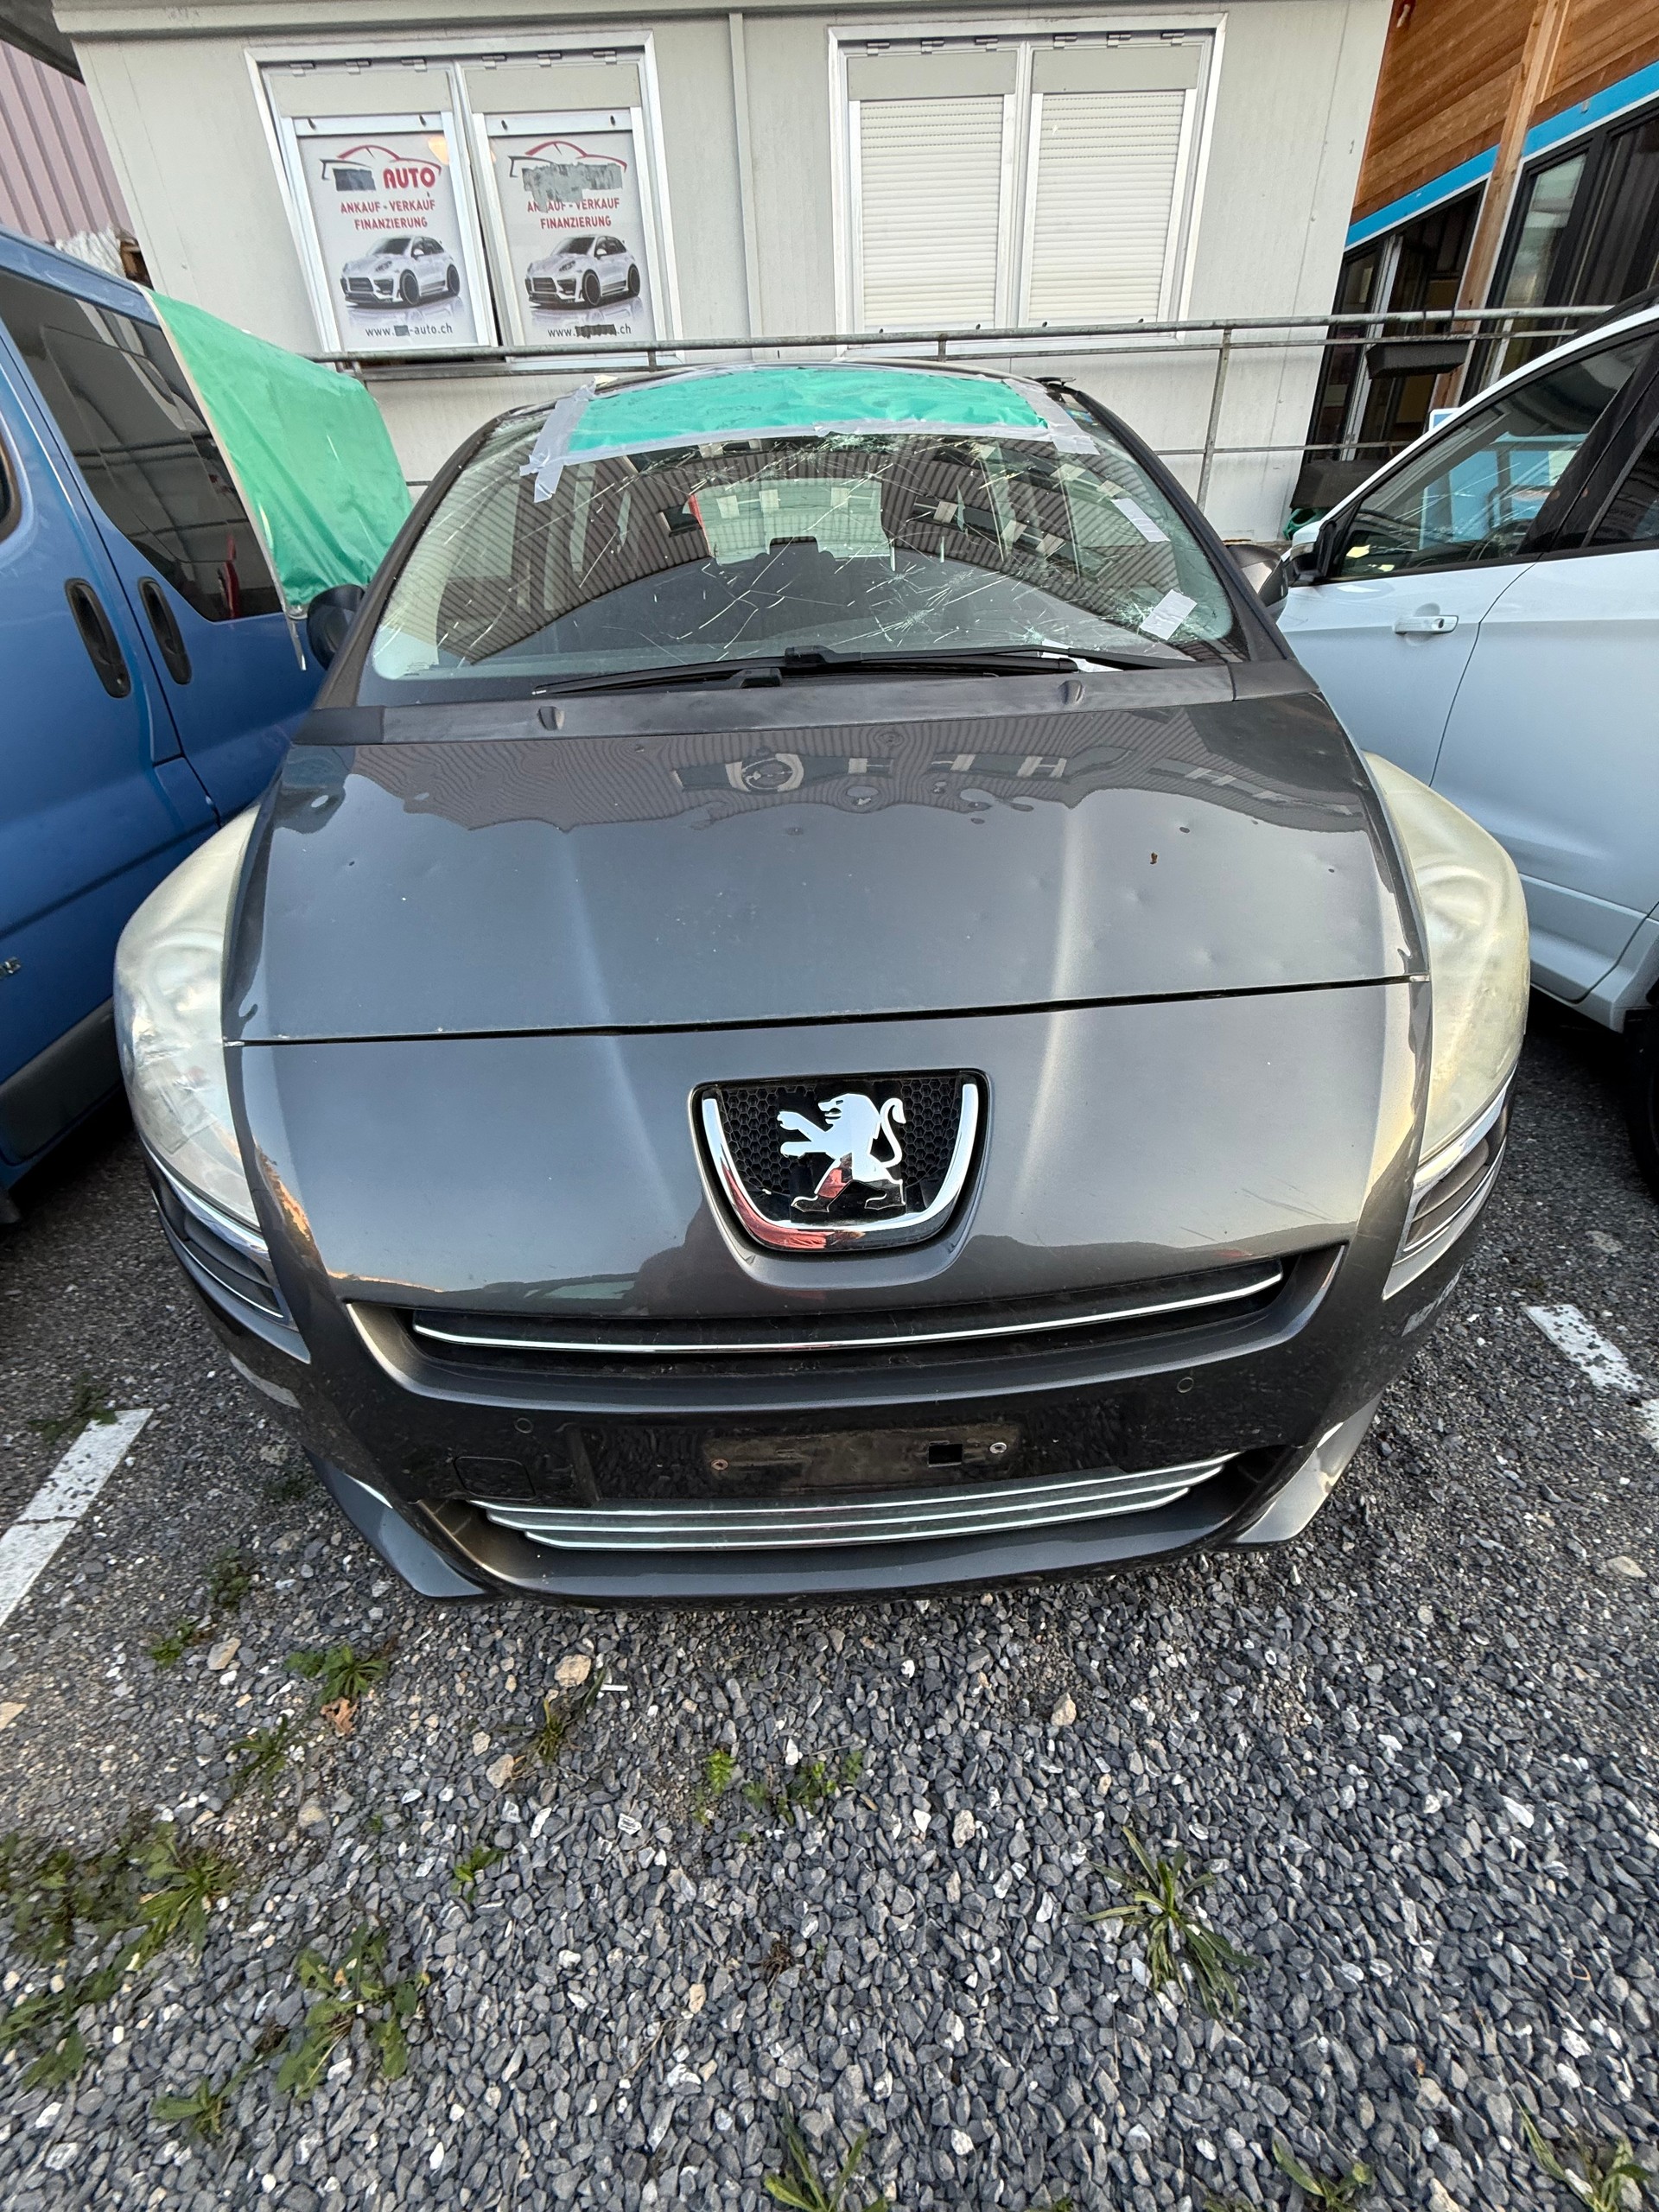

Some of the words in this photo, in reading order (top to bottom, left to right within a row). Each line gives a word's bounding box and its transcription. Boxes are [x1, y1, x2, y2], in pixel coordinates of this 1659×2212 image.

[383, 167, 435, 189] AUTO
[340, 200, 380, 214] ANKAUF
[389, 199, 435, 212] VERKAUF
[527, 200, 565, 213] ANAUF
[575, 197, 620, 210] VERKAUF
[354, 217, 428, 231] FINANZIERUNG
[540, 215, 612, 229] FINANZIERUNG
[365, 322, 453, 337] www.-auto.ch
